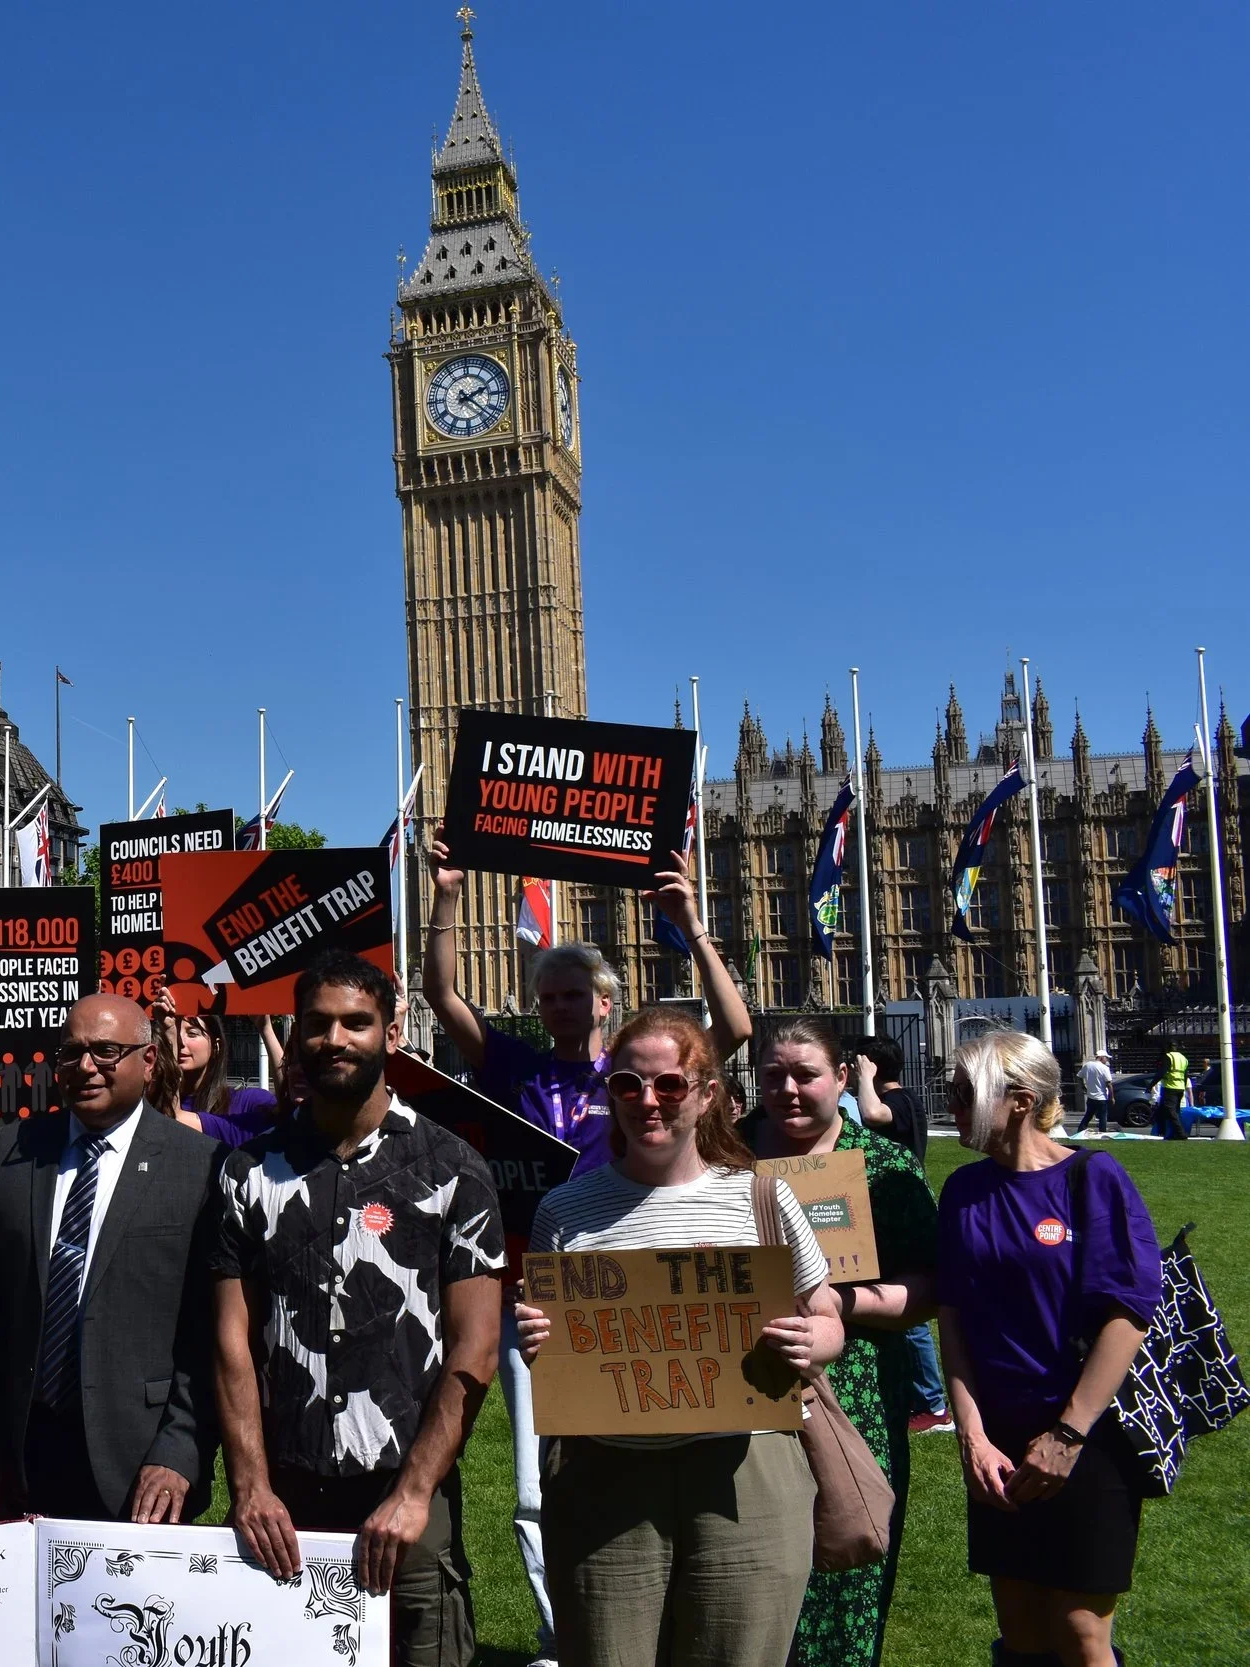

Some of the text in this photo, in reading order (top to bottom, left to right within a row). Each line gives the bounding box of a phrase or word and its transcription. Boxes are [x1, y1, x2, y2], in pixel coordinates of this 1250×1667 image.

[482, 741, 662, 789] I STAND WITH
[480, 778, 657, 826] YOUNG PEOPLE
[110, 829, 222, 860] COUNCILS NEED
[474, 813, 653, 851] FACING HOMELESSNESS
[111, 860, 152, 885] £400
[111, 892, 157, 912] TO HELP
[216, 874, 310, 946] END THE
[234, 870, 375, 976] BENEFIT TRAP
[37, 958, 79, 975] FACED
[62, 981, 79, 1000] IN
[38, 1007, 71, 1028] YEA
[766, 1155, 827, 1176] YOUNG
[812, 1216, 841, 1224] Chapter
[1038, 1224, 1063, 1233] CENTRE
[1040, 1232, 1060, 1241] POINT
[526, 1250, 754, 1302] END THE
[565, 1302, 760, 1354] BENEFIT
[600, 1358, 720, 1412] TRAP
[92, 1593, 253, 1667] Youth
